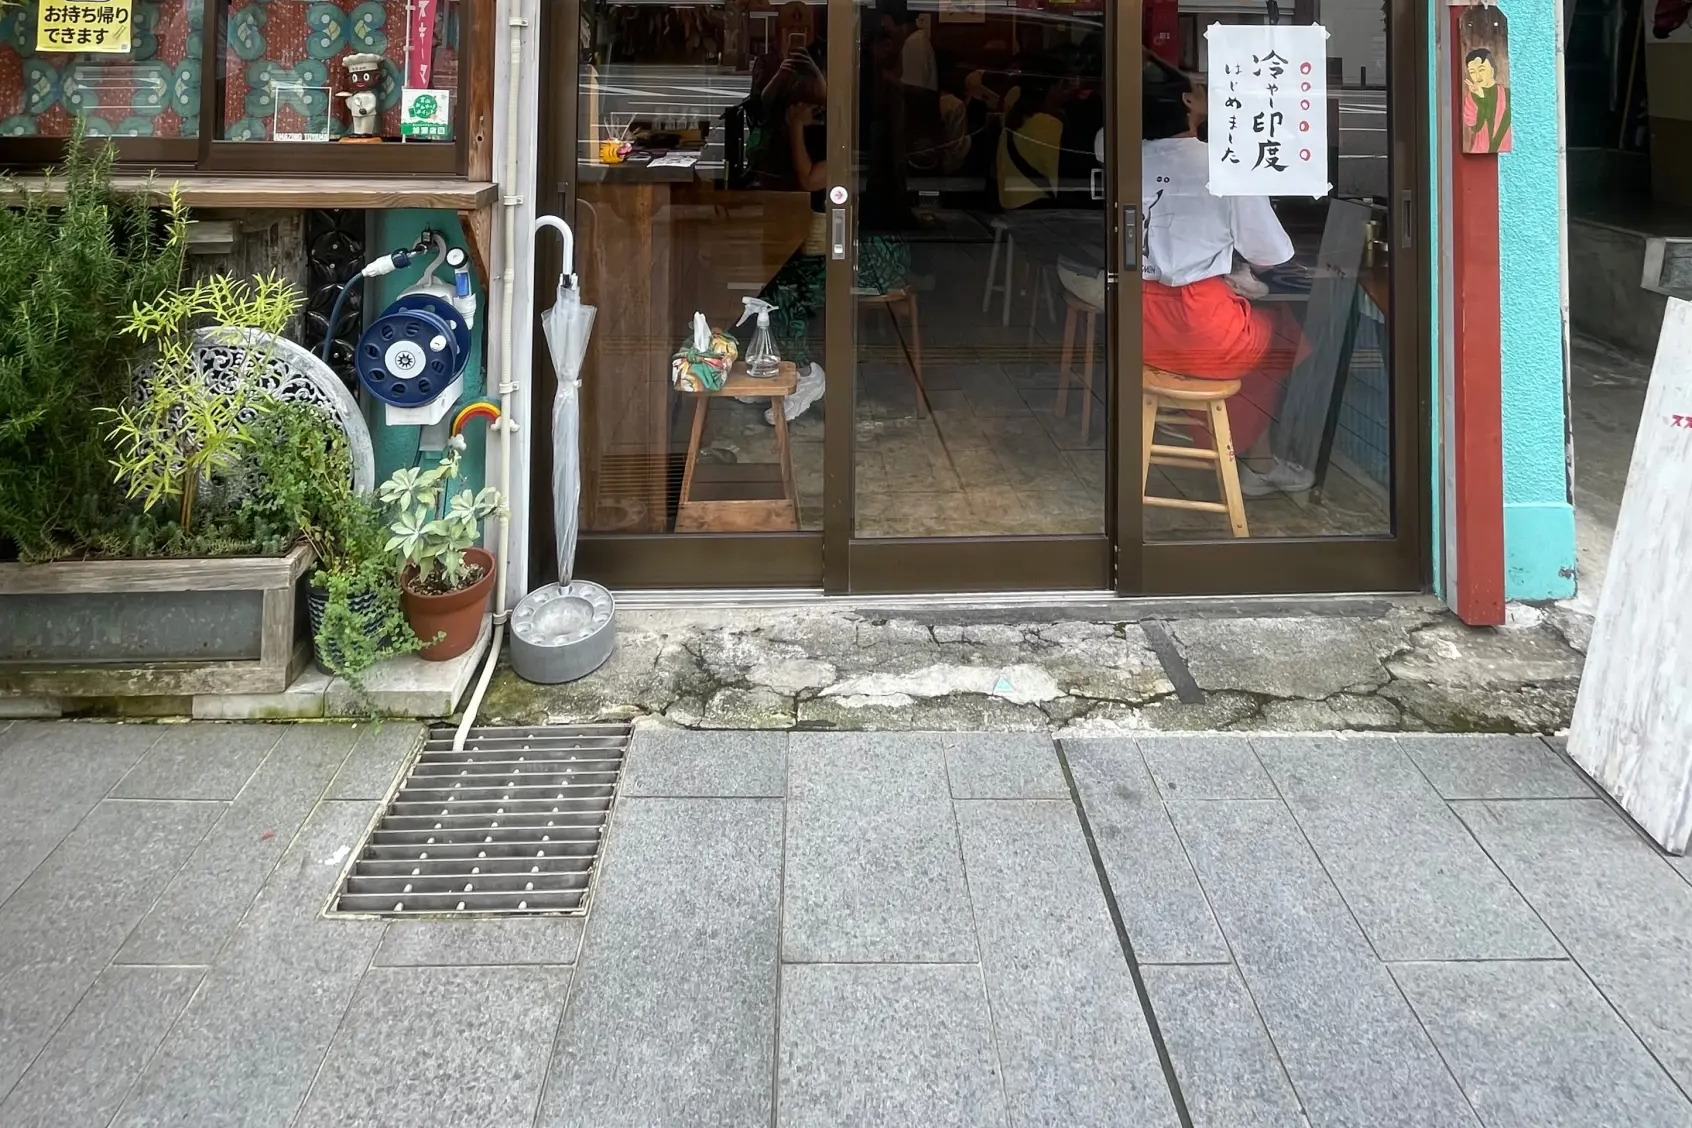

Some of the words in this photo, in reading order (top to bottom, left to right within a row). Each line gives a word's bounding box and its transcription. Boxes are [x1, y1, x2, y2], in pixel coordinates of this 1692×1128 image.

[44, 5, 129, 24] お持ち帰り
[44, 27, 109, 44] できます
[1221, 60, 1243, 164] はじめました
[1251, 50, 1290, 172] 冷やし印度
